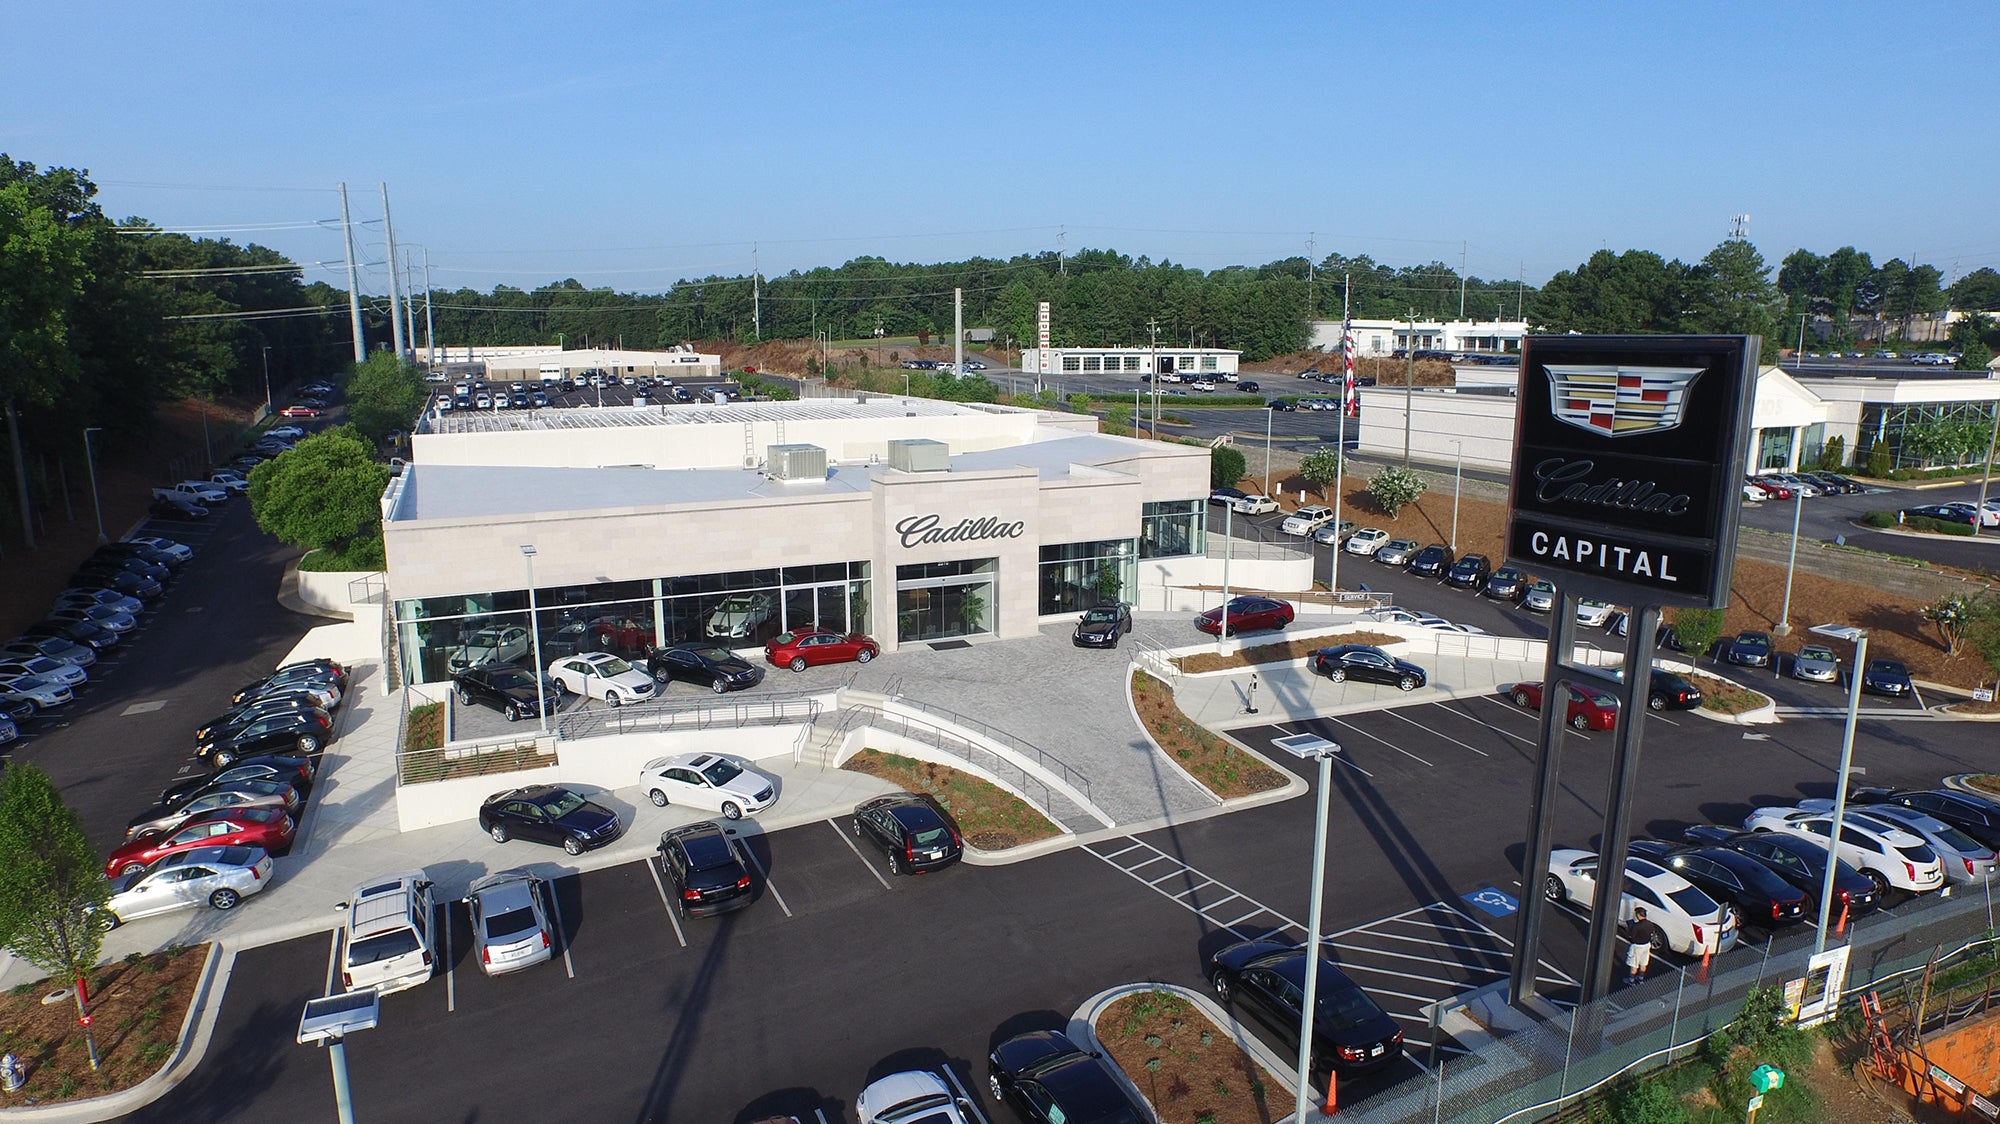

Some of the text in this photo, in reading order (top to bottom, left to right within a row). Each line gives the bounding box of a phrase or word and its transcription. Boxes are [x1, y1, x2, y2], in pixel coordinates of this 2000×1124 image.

[1041, 313, 1049, 368] HUMMER
[1533, 457, 1690, 517] Cadillac
[895, 514, 1025, 549] Cadillac
[1531, 531, 1678, 582] CAPITAL
